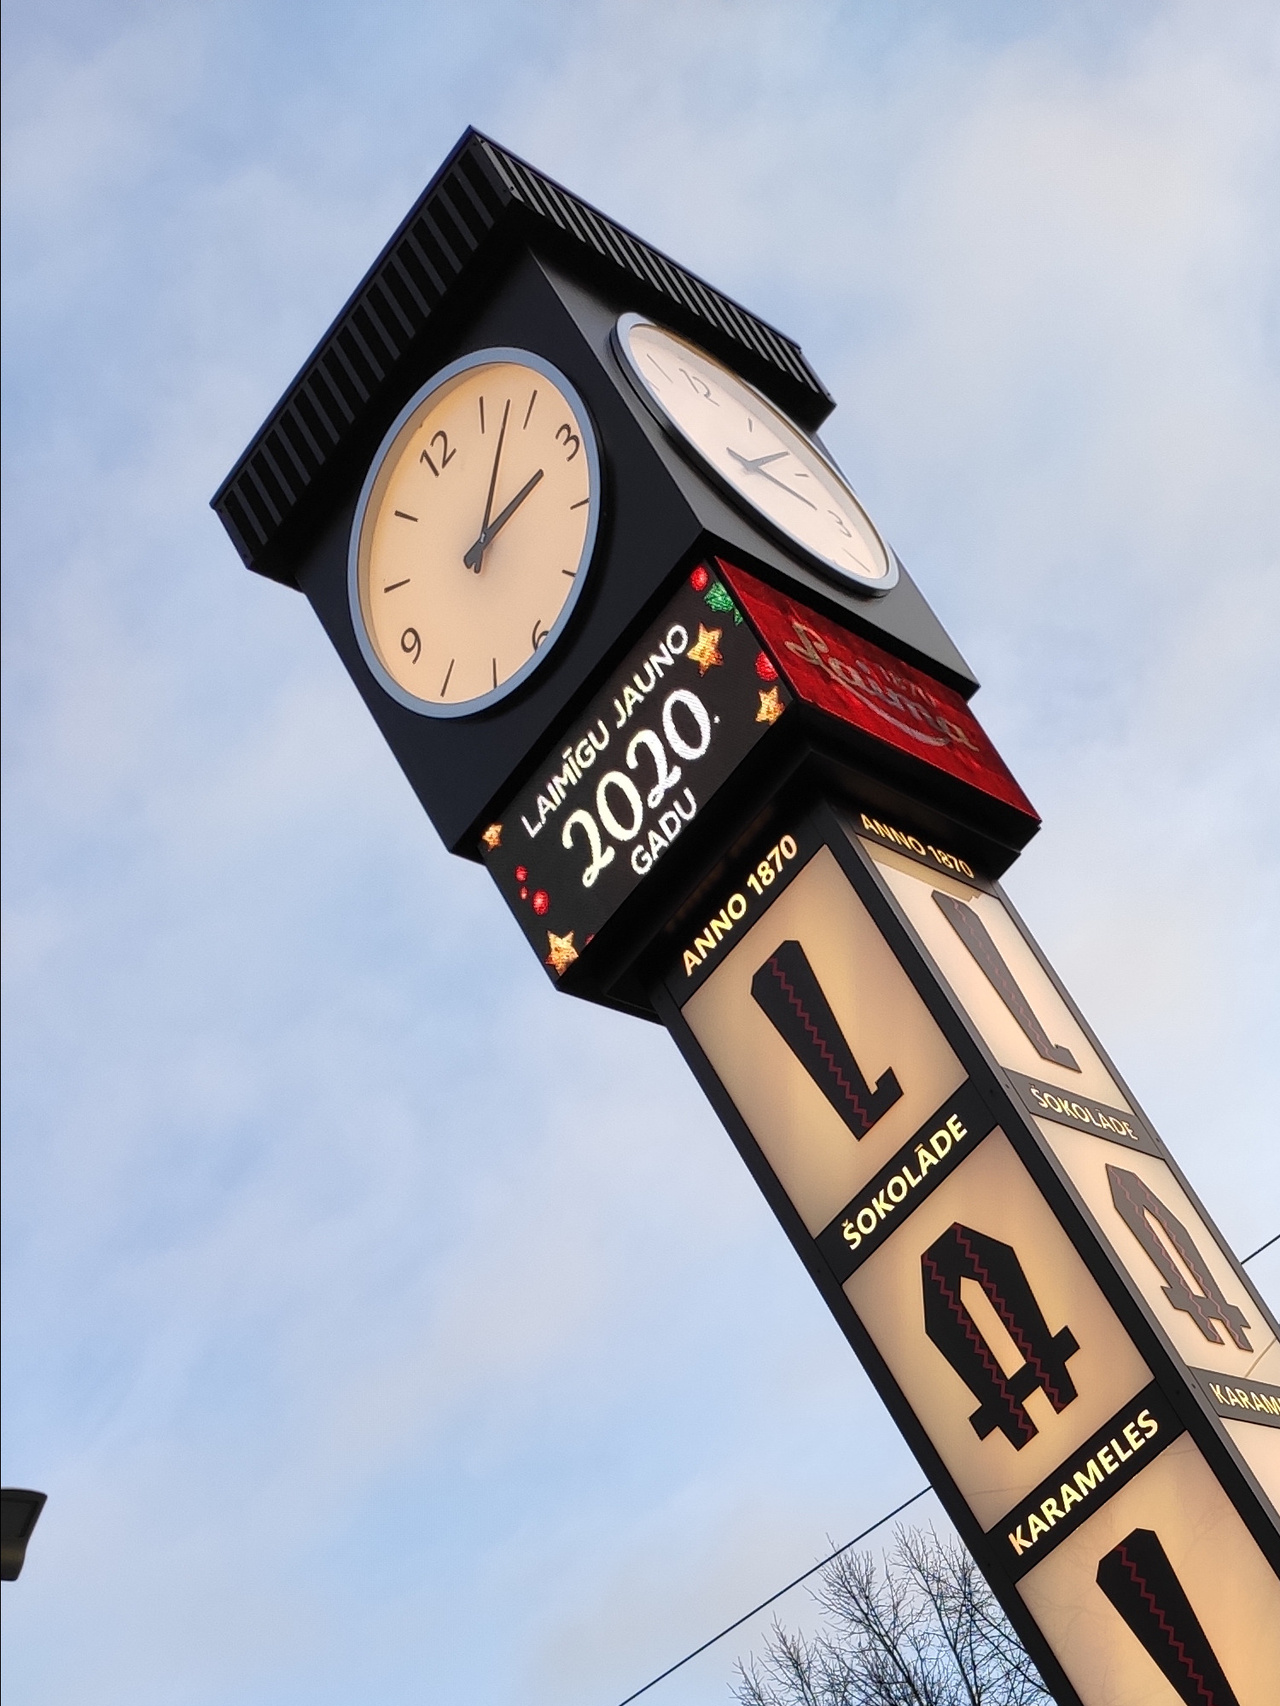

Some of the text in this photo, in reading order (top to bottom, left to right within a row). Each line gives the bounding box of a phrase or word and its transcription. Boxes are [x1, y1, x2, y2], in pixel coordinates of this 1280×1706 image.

[419, 429, 457, 478] 12
[555, 423, 581, 462] 3
[400, 627, 421, 665] 9
[520, 624, 689, 839] LAIMĪGU JAUNO
[631, 787, 697, 875] GADU
[860, 813, 975, 878] ANNO 1870
[681, 834, 798, 977] ANNO 1870
[1031, 1083, 1139, 1141] ŠOKOLĀDE
[842, 1114, 968, 1250] ŠOKOLĀDE
[1008, 1409, 1158, 1555] KARAMELES
